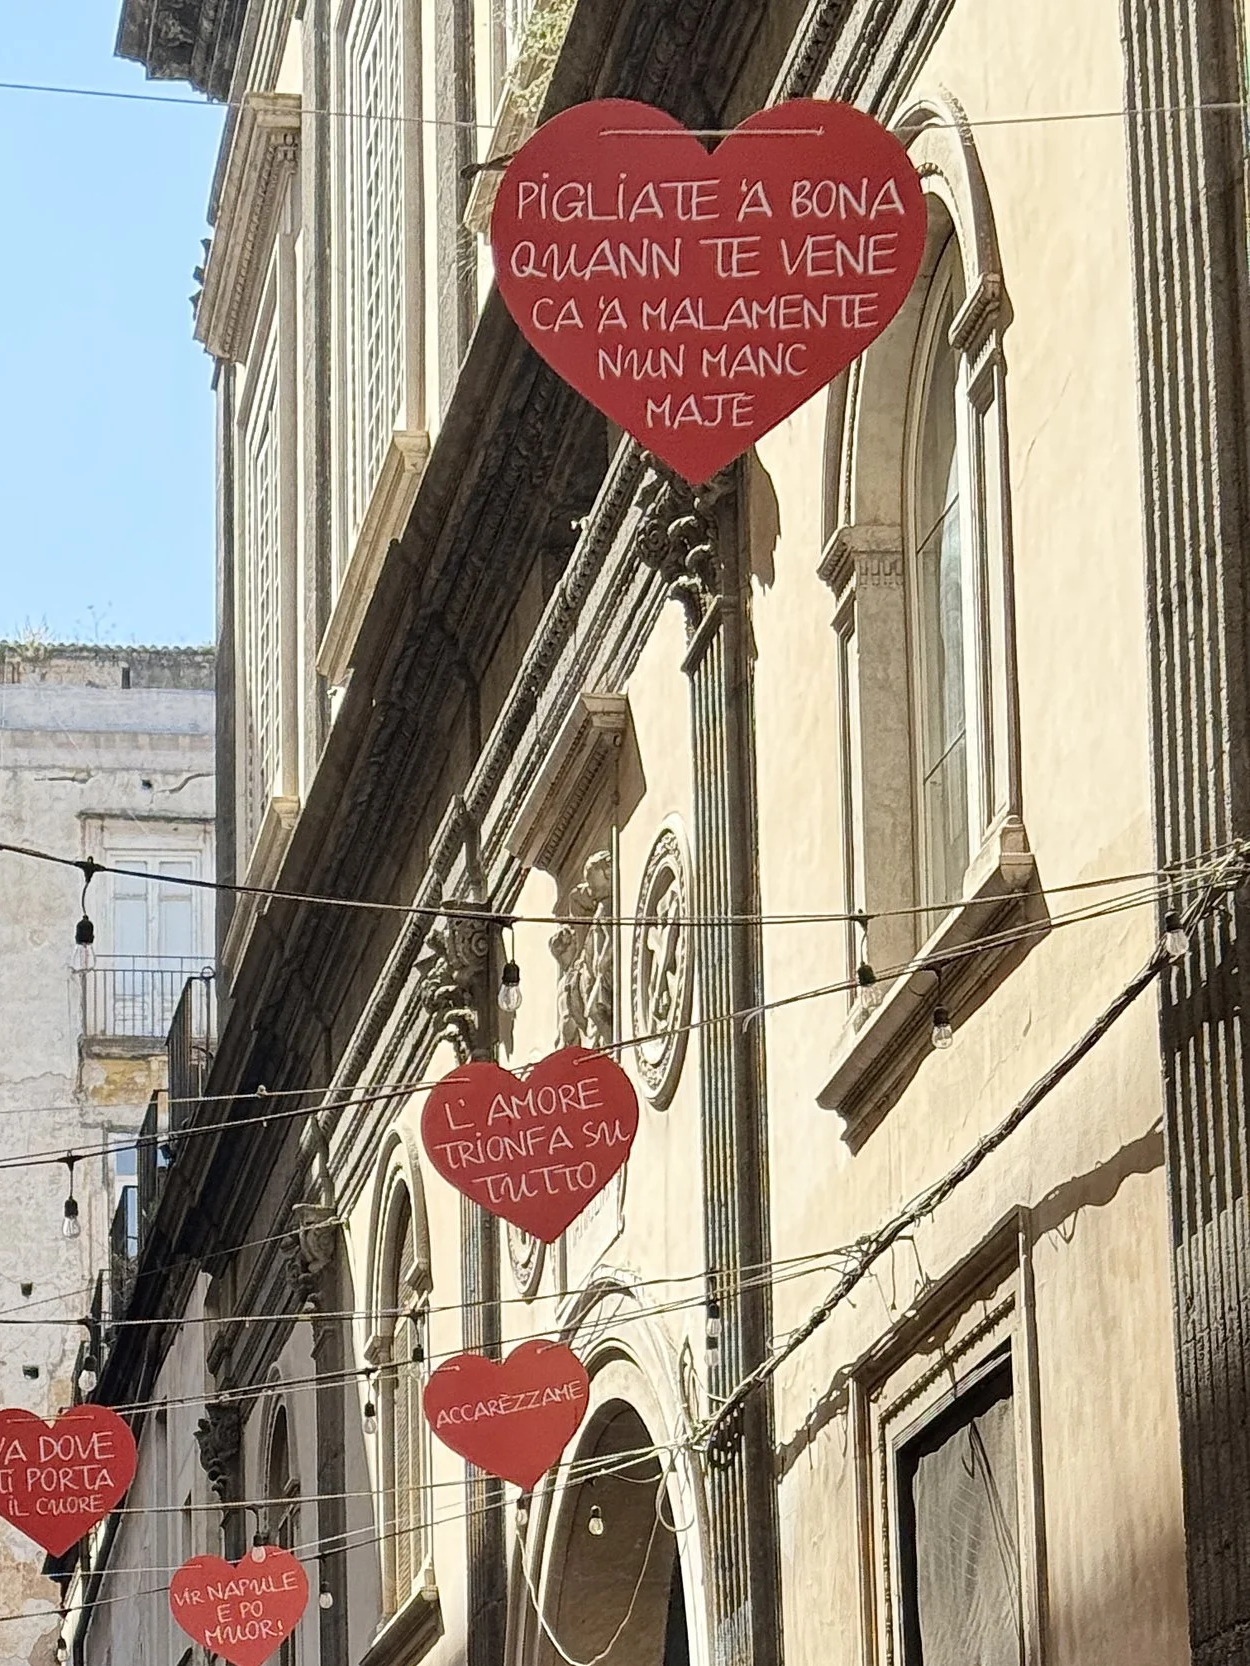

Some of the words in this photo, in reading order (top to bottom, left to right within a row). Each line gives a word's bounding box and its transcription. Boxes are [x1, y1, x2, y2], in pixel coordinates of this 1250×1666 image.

[792, 177, 905, 219] BONA
[510, 237, 682, 282] QUANN
[699, 237, 761, 279] TE
[780, 233, 898, 278] VENE
[532, 297, 582, 333] CA
[643, 293, 879, 332] MALAMENTE
[597, 344, 684, 380] NUN
[702, 342, 807, 378] MANC
[646, 392, 754, 429] MAJE
[487, 1078, 604, 1125] AMORE
[434, 1126, 574, 1169] TRIONFA
[472, 1161, 596, 1204] TUTTO
[39, 1431, 115, 1463] DOVE
[27, 1464, 115, 1492] PORTA
[36, 1494, 105, 1516] CUORE
[207, 1571, 298, 1600] NAPULE
[217, 1604, 232, 1624] E
[239, 1600, 263, 1618] PO
